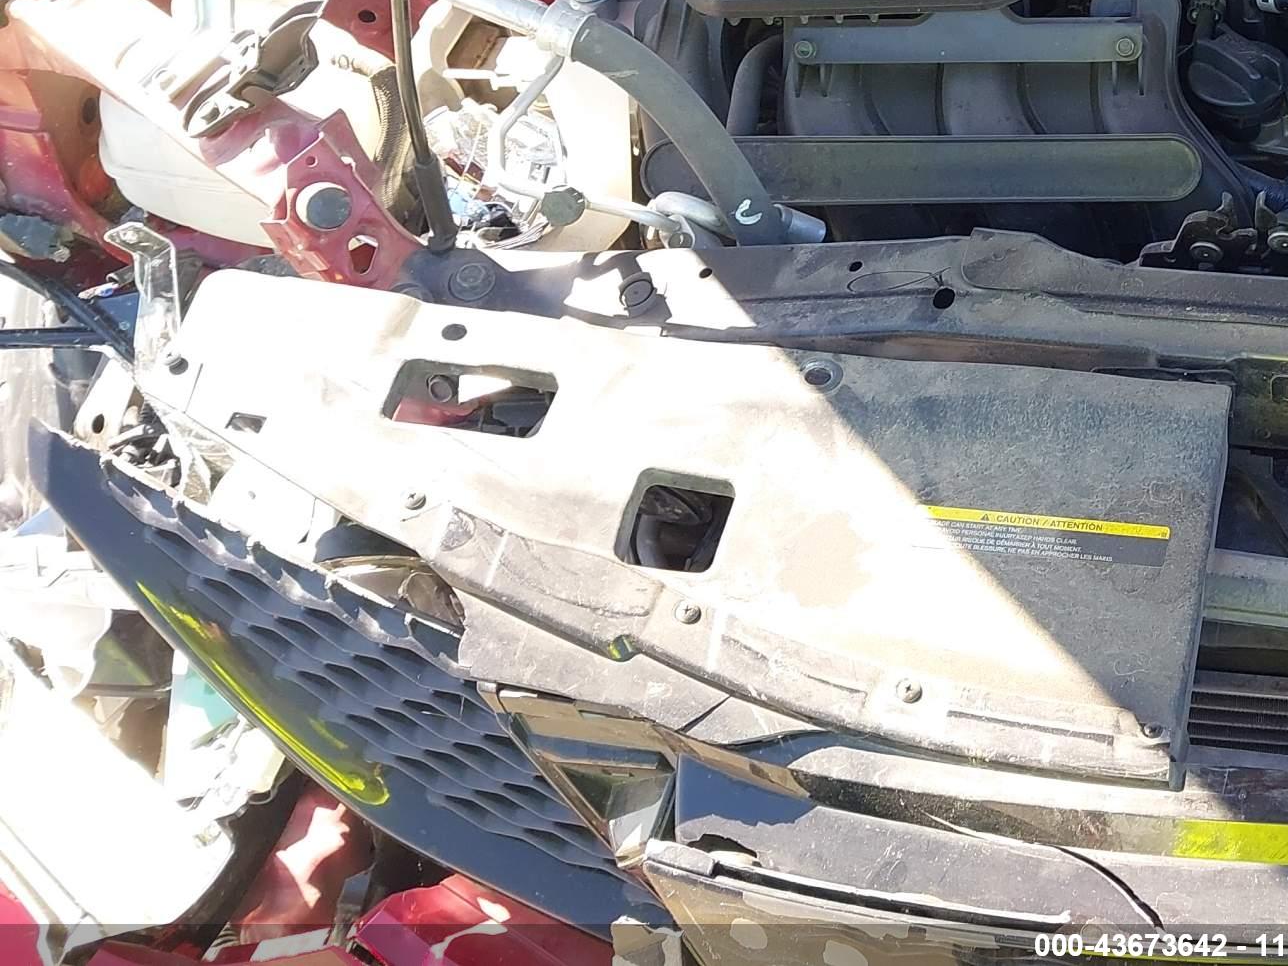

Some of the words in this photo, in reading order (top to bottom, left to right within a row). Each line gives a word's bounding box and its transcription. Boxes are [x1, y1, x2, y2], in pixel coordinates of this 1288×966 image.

[996, 515, 1040, 525] CAUTION
[1050, 520, 1104, 531] ATTENTION
[1037, 542, 1053, 550] TOUT
